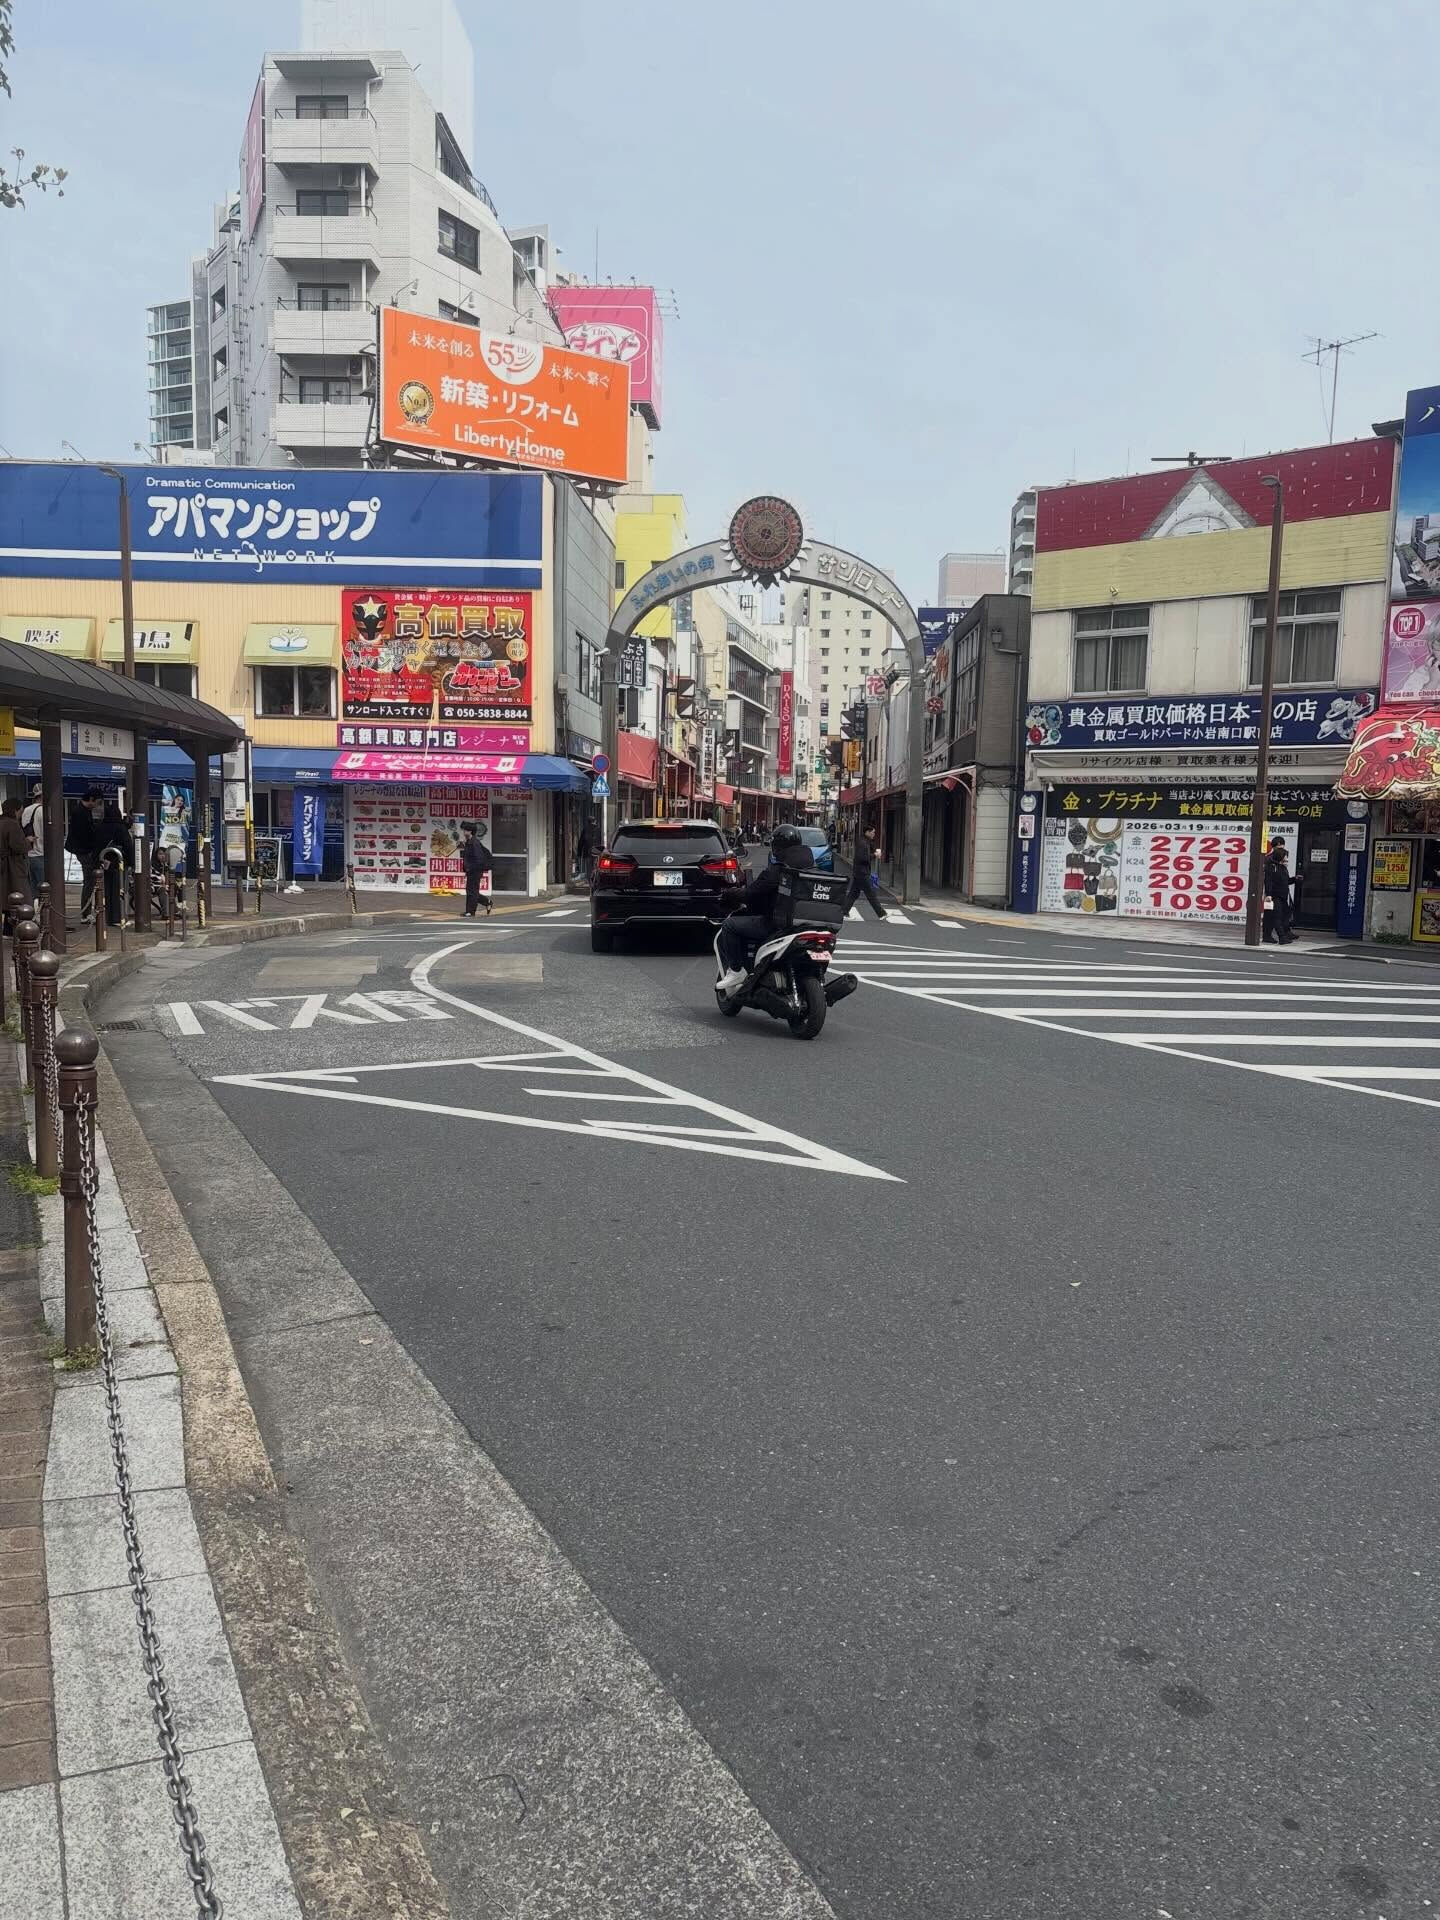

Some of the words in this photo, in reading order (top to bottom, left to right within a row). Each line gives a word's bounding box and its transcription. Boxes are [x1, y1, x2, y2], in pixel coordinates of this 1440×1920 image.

[408, 329, 475, 358] 未来を創る
[487, 340, 514, 366] 55
[548, 363, 610, 389] 未来へ繋ぐ
[440, 375, 580, 428] 新築・リフォーム
[146, 477, 201, 488] Dramatic
[205, 478, 295, 490] Communication
[147, 492, 381, 542] アパマンショップ
[263, 549, 336, 563] WORK
[818, 553, 905, 609] サンロード
[394, 603, 526, 639] 高価買取
[25, 629, 61, 643] 喫茶
[867, 676, 885, 696] 花
[783, 684, 791, 722] DAISO
[456, 707, 528, 719] 050-5838-8844
[341, 727, 457, 747] 高額買取専門店
[1094, 724, 1284, 742] 買取ゴールドバード小岩南口駅店
[1149, 775, 1300, 784] 初めての方もお気軽にご相ください
[1063, 789, 1163, 811] 金・プラチナ
[1169, 789, 1337, 801] 当店より高く買取るはございません
[430, 803, 488, 818] 即日現金
[303, 795, 313, 861] アパマンショップ
[1213, 824, 1294, 834] 本日の貴金取価格
[1131, 836, 1142, 846] 金
[1150, 835, 1273, 857] 2723
[1126, 858, 1145, 866] K24
[813, 883, 832, 892] Uber
[1125, 875, 1143, 883] K18
[812, 891, 830, 900] Eats
[1149, 891, 1249, 912] 1090
